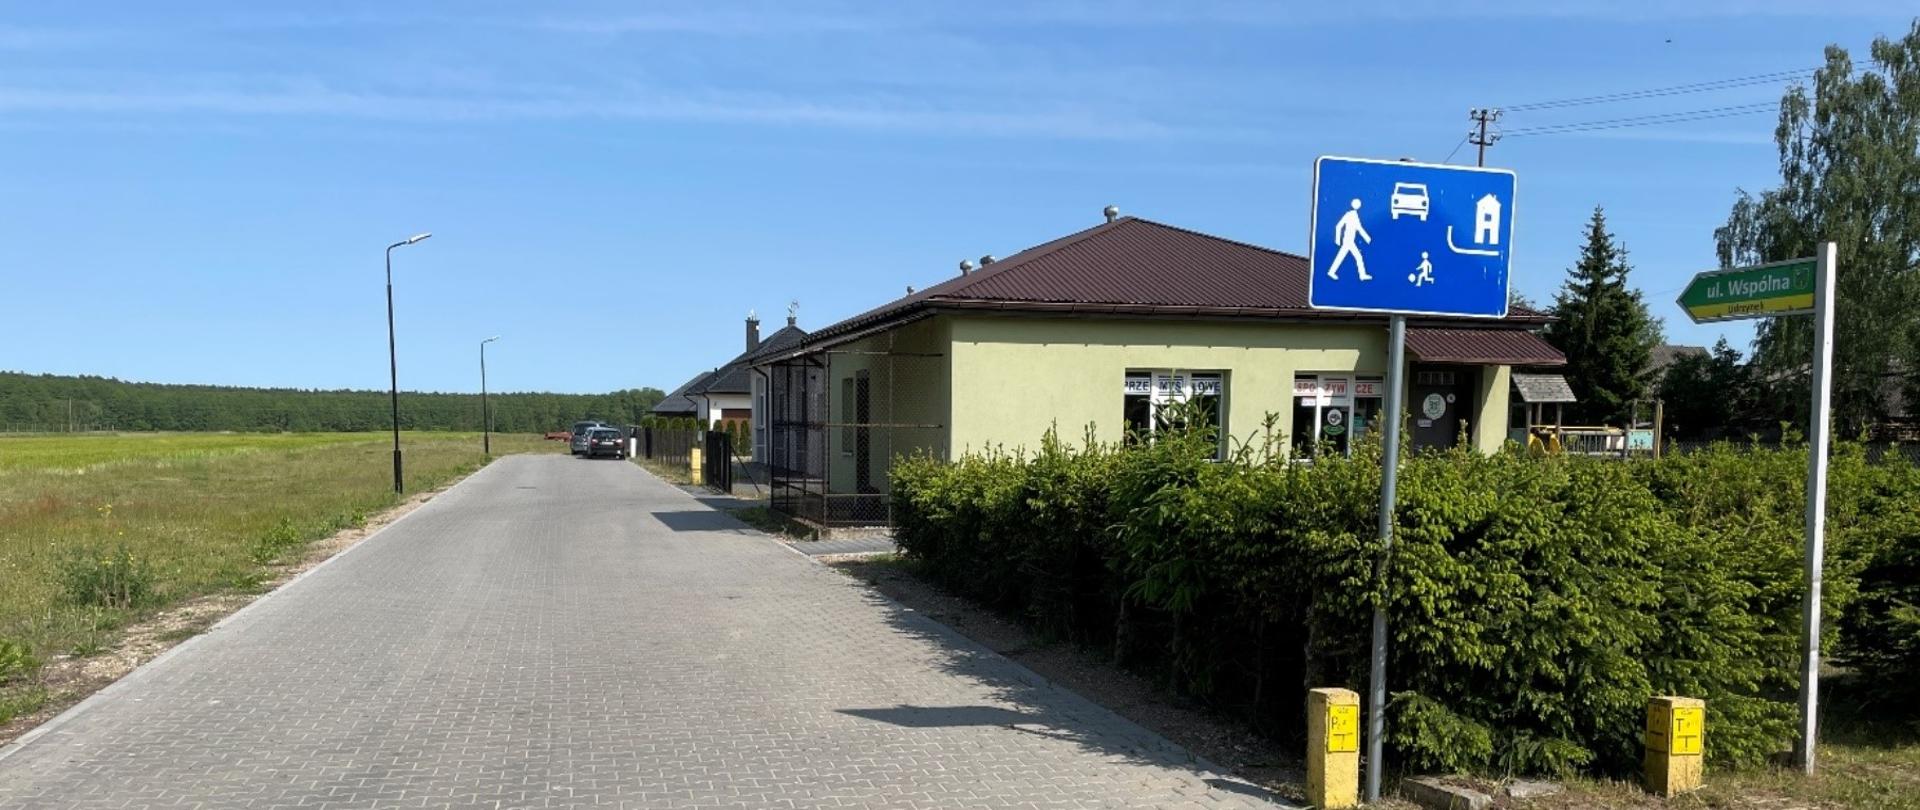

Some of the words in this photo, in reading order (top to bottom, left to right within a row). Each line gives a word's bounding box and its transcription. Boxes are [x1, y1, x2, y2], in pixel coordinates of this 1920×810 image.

[1707, 282, 1724, 298] ul.
[1728, 274, 1790, 297] Wspólna
[1355, 383, 1373, 394] CZE
